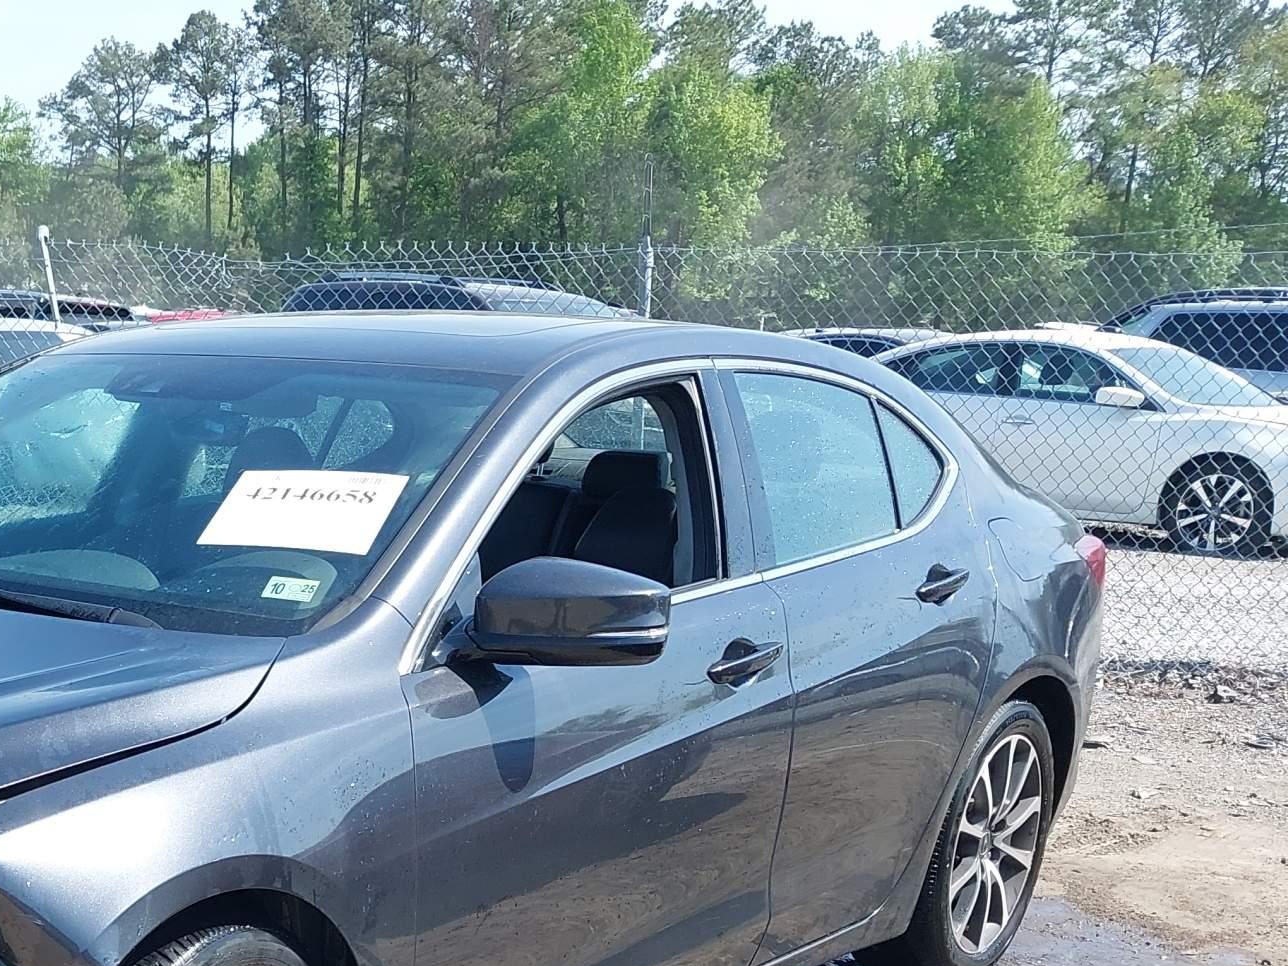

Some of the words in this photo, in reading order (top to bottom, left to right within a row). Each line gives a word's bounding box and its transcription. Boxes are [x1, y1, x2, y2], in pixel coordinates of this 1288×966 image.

[246, 486, 377, 504] 42146658
[270, 582, 286, 595] 10
[301, 584, 317, 594] 25
